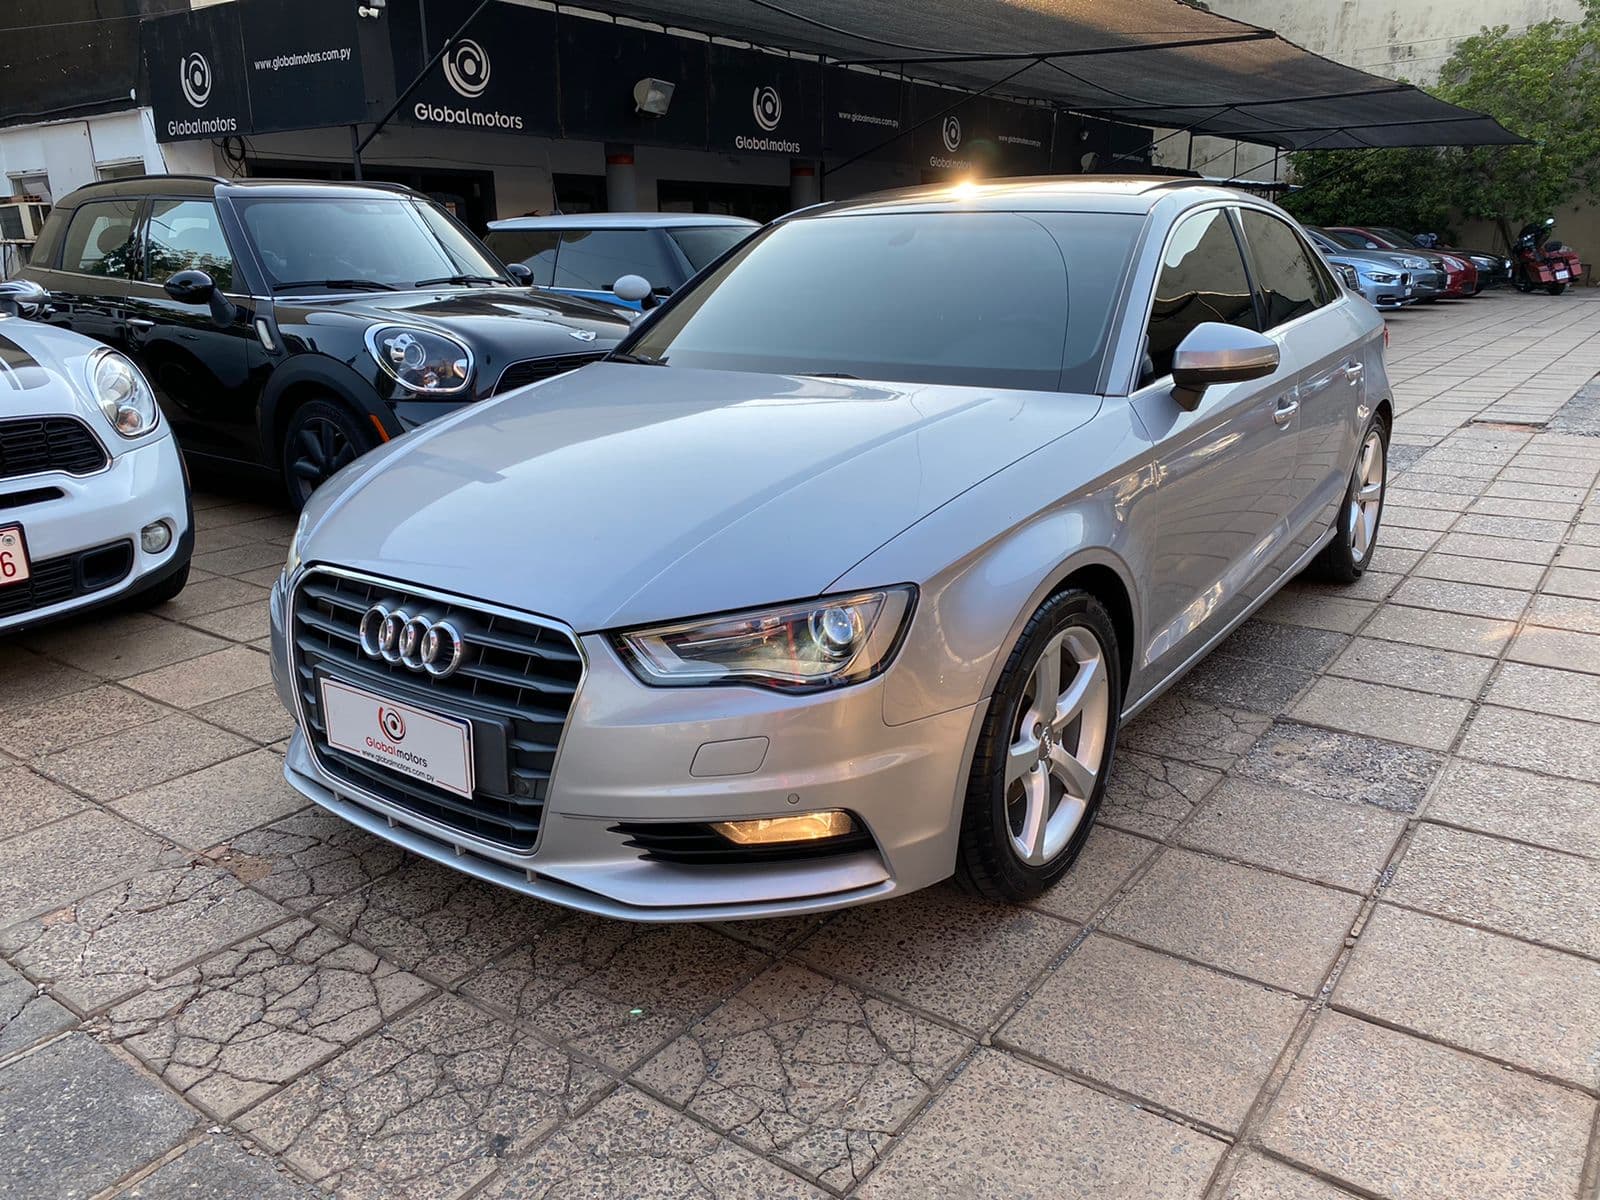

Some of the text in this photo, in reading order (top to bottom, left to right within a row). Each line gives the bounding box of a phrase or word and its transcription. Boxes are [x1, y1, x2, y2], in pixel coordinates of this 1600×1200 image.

[254, 48, 351, 71] www.globalmotors.com.py
[414, 102, 523, 130] Globalmotors
[168, 117, 237, 137] Globalmotors
[735, 135, 800, 154] Globalmotors
[929, 156, 973, 169] Globalmotor
[366, 736, 428, 768] Globalmotors
